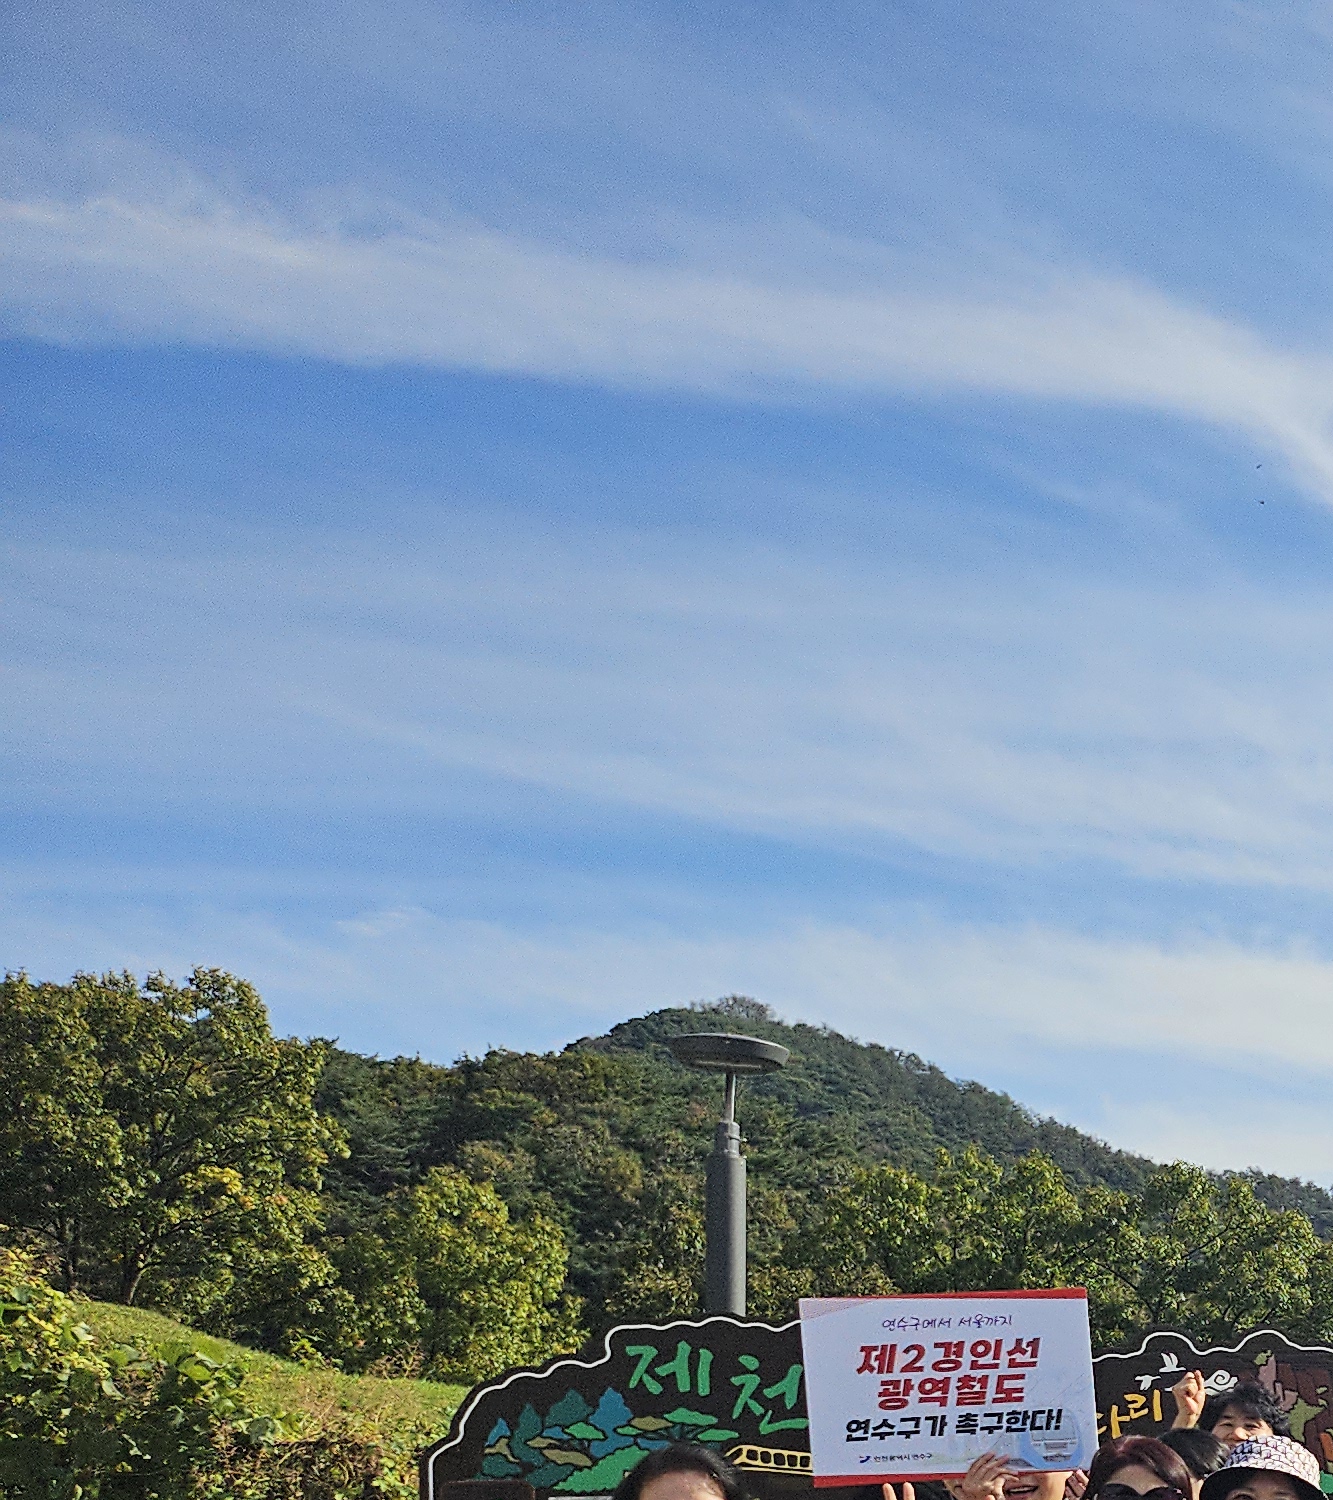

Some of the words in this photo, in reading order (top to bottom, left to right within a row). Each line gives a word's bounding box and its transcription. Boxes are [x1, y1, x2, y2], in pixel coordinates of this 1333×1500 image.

[882, 1316, 951, 1331] 연수구에서
[958, 1313, 1012, 1328] 서울까지
[856, 1337, 1041, 1375] 제2경인선
[625, 1340, 809, 1435] 제천
[878, 1373, 1027, 1411] 광역철도
[845, 1410, 948, 1442] 연수구가
[955, 1408, 1063, 1436] 촉구한다!
